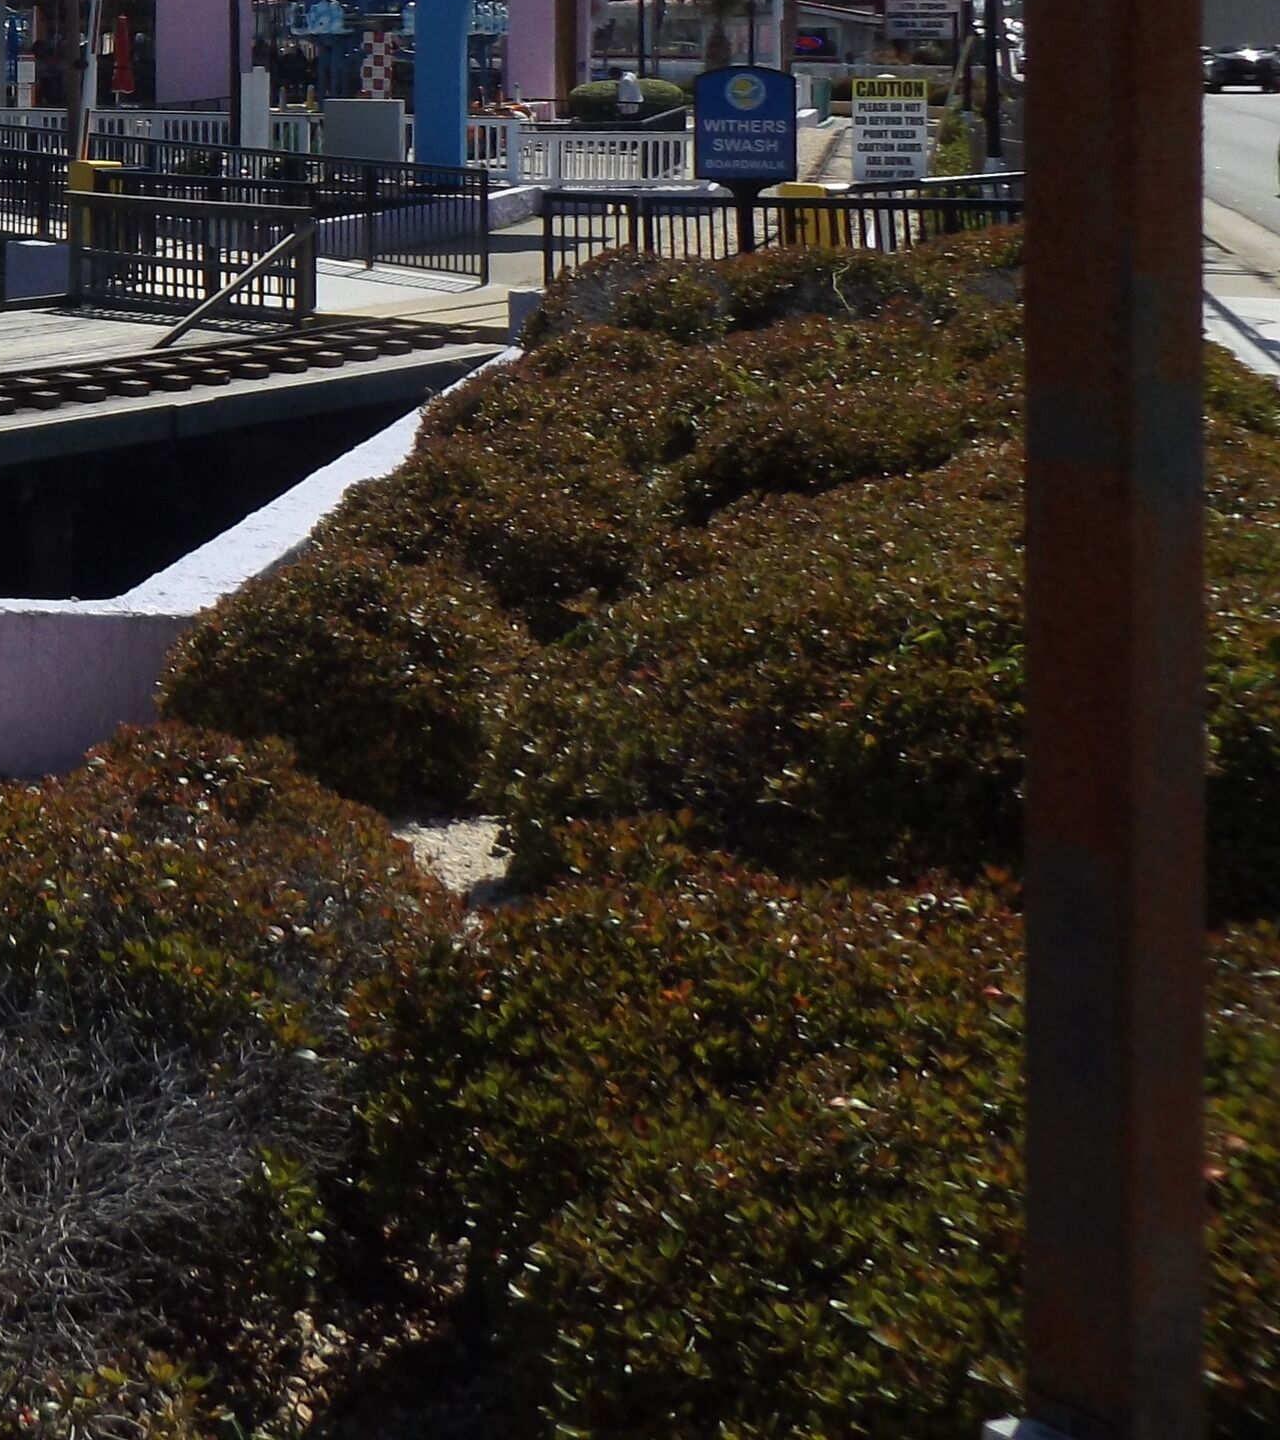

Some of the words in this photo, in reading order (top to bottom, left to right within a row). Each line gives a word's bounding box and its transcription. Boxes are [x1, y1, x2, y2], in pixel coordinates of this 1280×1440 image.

[856, 81, 924, 97] CAUTION
[858, 103, 888, 112] PLEASE
[904, 103, 921, 112] NOT
[703, 119, 786, 133] WITHERS
[713, 139, 778, 152] SWASH
[857, 143, 895, 152] CAUTION
[705, 159, 785, 169] BOARDWALK
